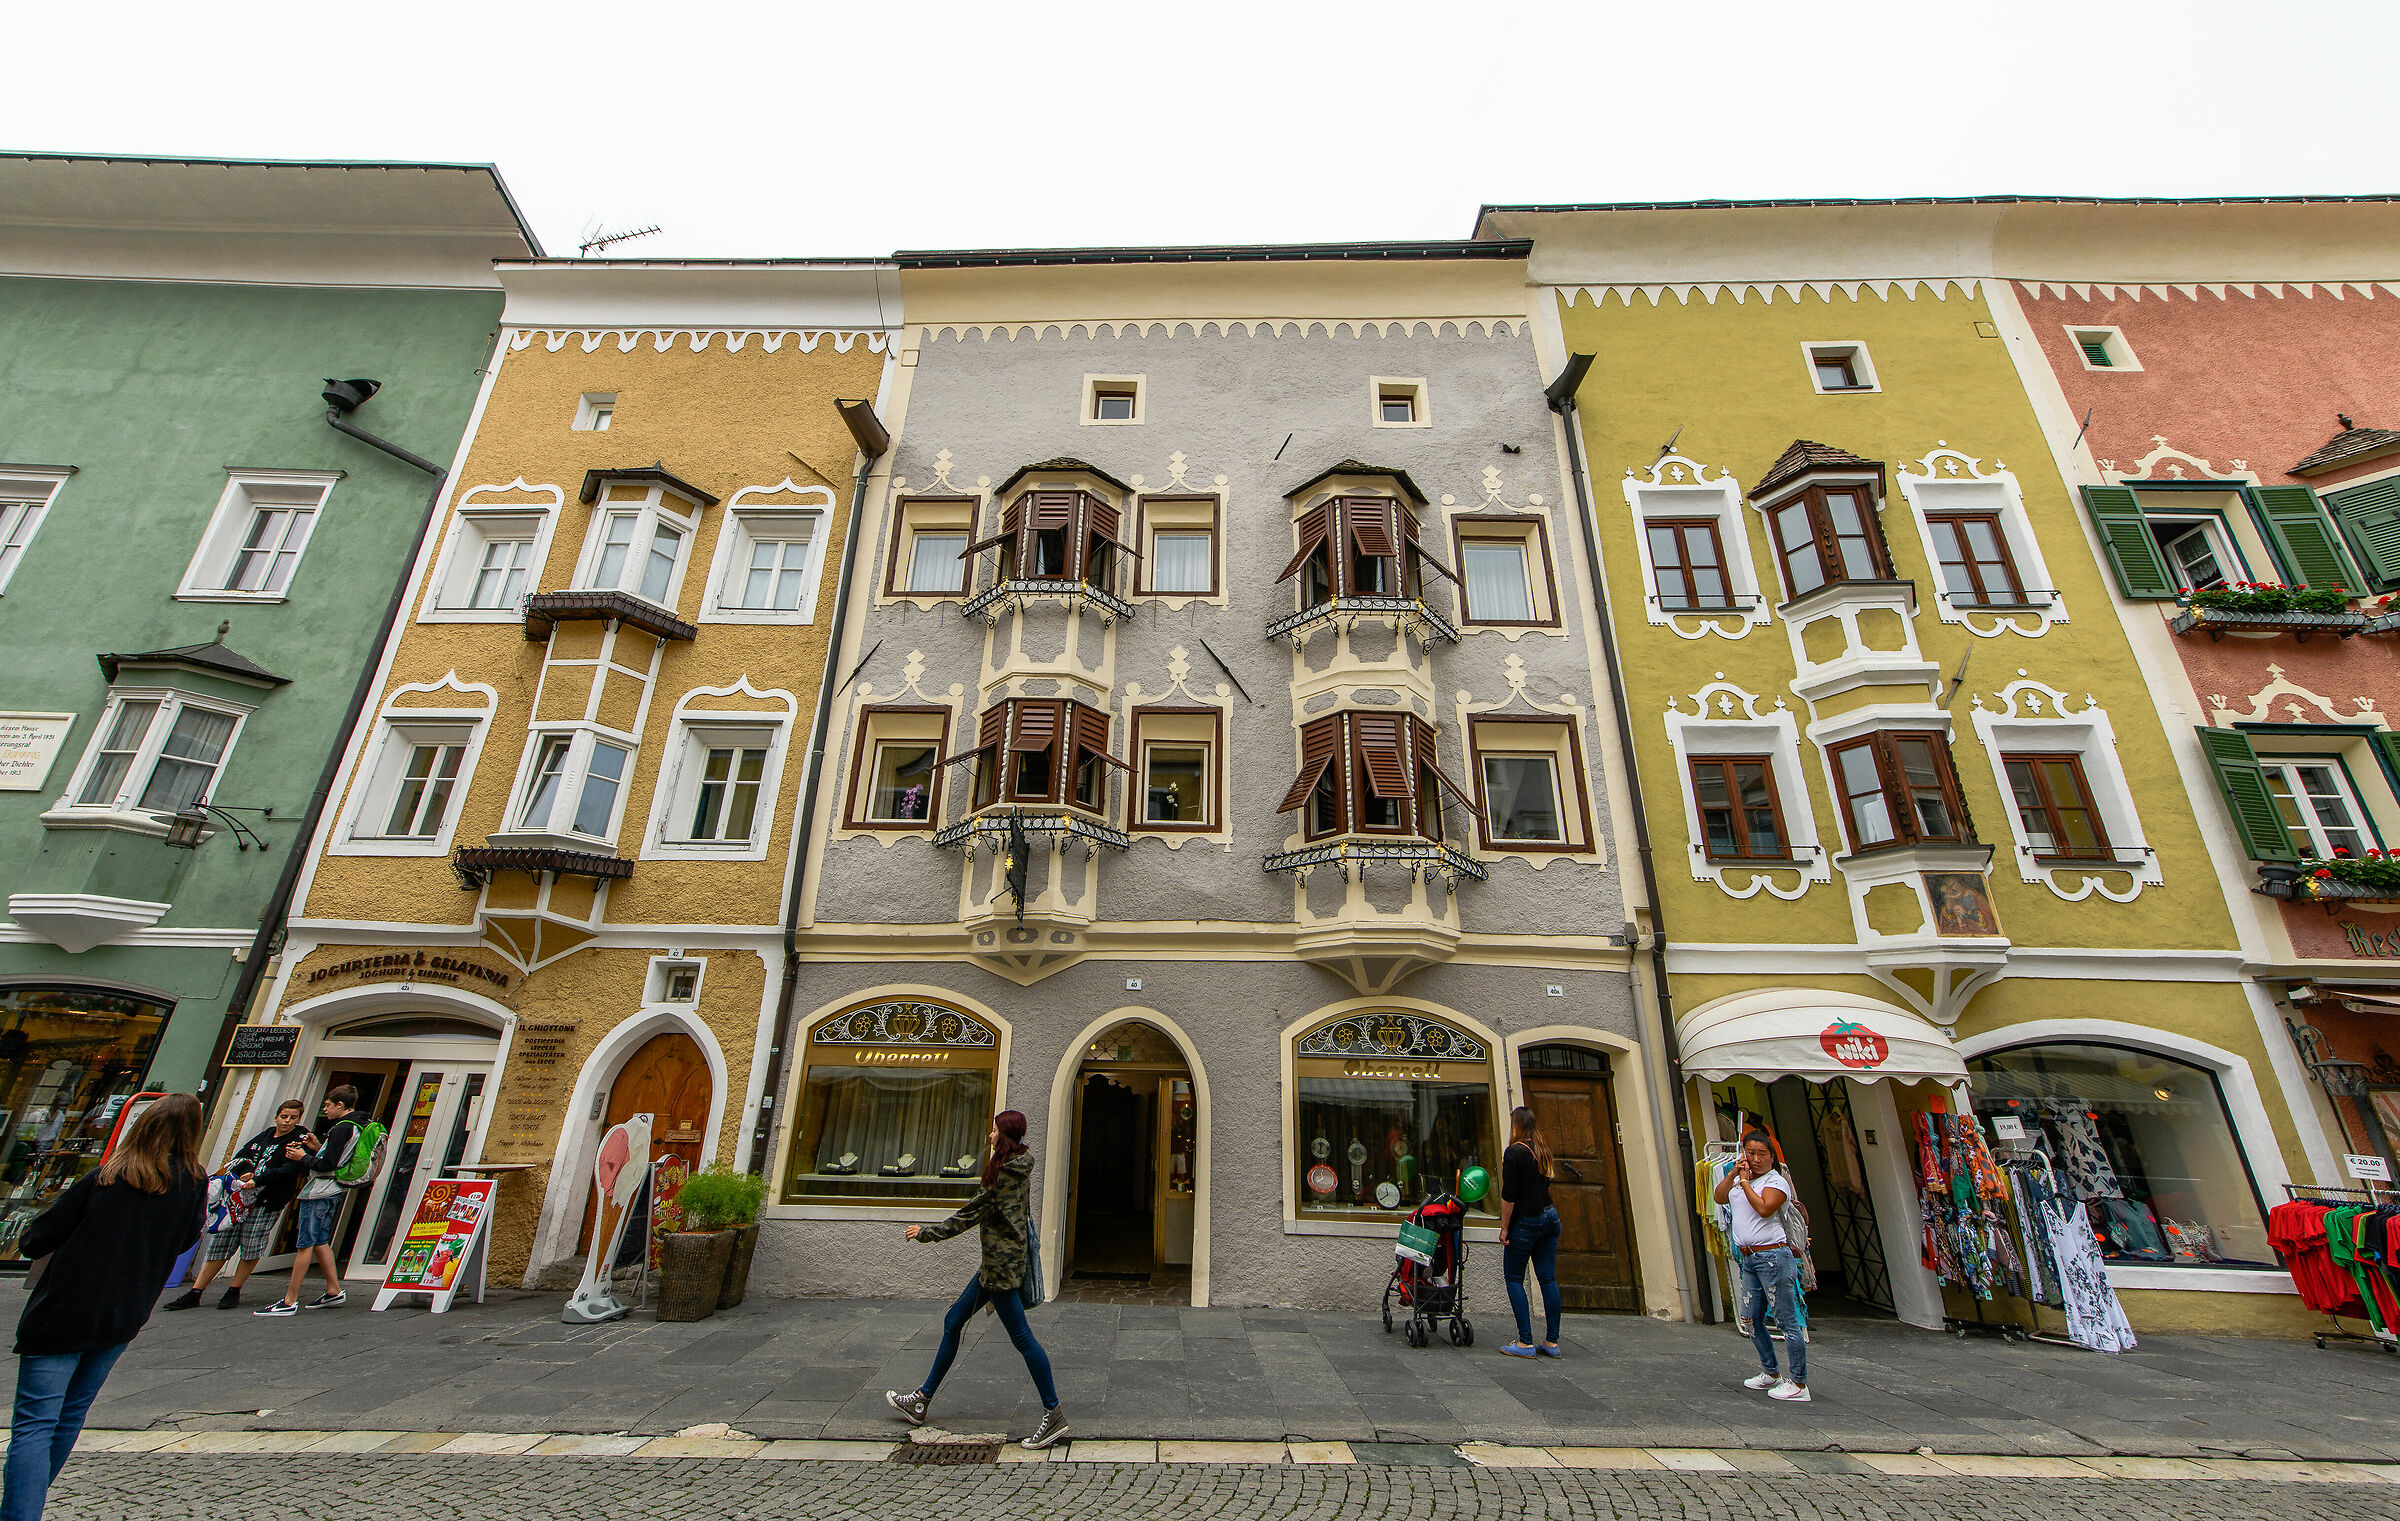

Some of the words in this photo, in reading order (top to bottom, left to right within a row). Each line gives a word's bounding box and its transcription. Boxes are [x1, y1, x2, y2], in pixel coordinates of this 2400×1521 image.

[2338, 921, 2400, 956] Res
[307, 953, 410, 983] JOGURTERIA
[413, 950, 426, 966] &
[430, 956, 509, 988] GELATERIA
[358, 968, 405, 980] JOGHURT
[417, 969, 460, 982] EISDIELE
[527, 1024, 576, 1032] GHIOTTONE
[1343, 1060, 1441, 1079] Oberretl
[2350, 1157, 2356, 1165] €
[2357, 1158, 2381, 1167] 20.00
